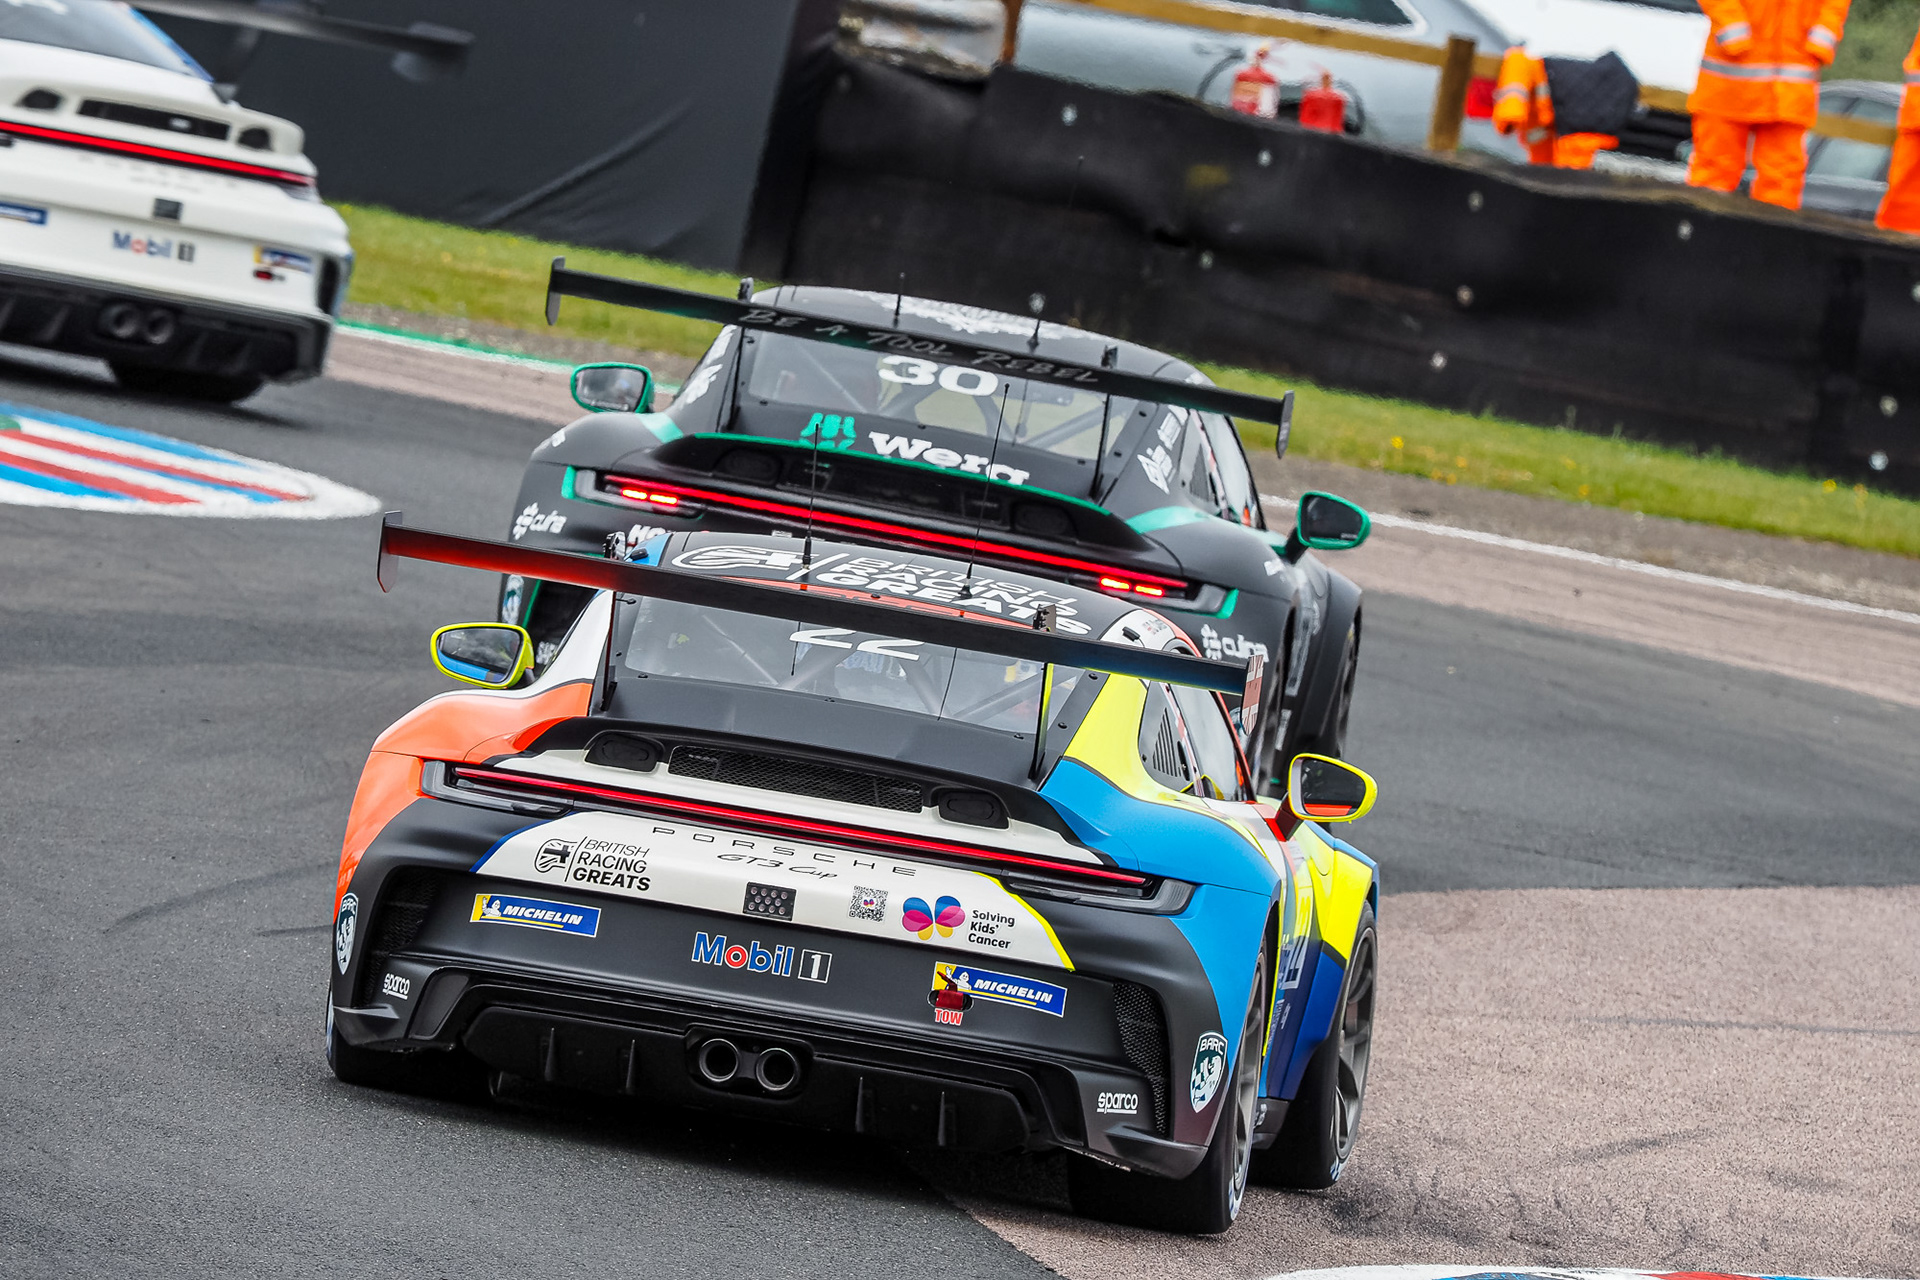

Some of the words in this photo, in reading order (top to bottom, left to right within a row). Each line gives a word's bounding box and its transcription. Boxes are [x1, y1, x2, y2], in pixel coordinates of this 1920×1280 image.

[113, 230, 172, 258] Mobil
[739, 308, 807, 328] BE
[813, 324, 850, 336] A
[866, 331, 953, 357] TOOL
[970, 350, 1099, 384] REBEL
[878, 355, 999, 397] 30
[869, 431, 1031, 486] Wera
[830, 564, 1079, 617] RACING
[848, 556, 1078, 604] BRITISH
[816, 572, 1092, 635] GREATS
[583, 838, 650, 857] BRITISH
[652, 826, 916, 877] PORSCHE
[577, 852, 648, 874] RACING
[717, 852, 784, 869] GT3
[788, 865, 839, 880] Cup
[572, 867, 651, 892] GREATS
[502, 904, 584, 926] MICHELIN
[972, 909, 1016, 928] Solving
[968, 932, 1012, 949] Cancer
[692, 931, 795, 977] Mobil
[383, 973, 410, 997] sparco
[973, 978, 1053, 1004] MICHELIN
[934, 1008, 964, 1026] TOW
[1200, 1037, 1225, 1056] BARC
[1098, 1091, 1138, 1114] sparco
